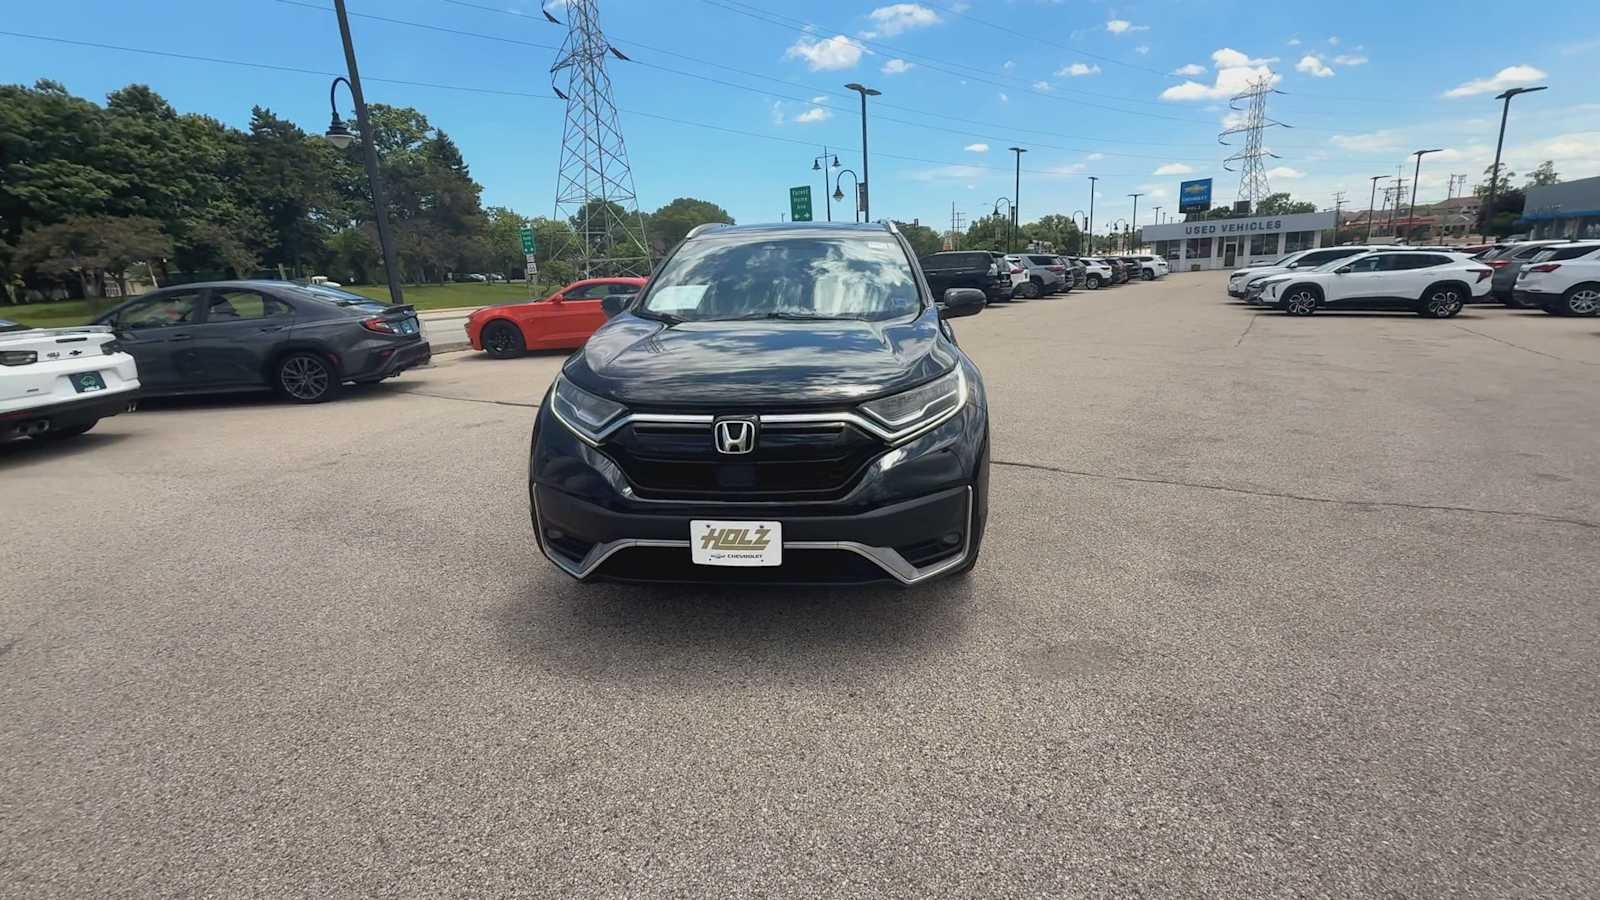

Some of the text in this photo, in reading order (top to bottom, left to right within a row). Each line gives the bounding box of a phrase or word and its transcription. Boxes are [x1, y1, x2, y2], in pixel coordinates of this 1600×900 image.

[1185, 219, 1283, 235] USED VEHICLES
[701, 528, 772, 551] HOLZ
